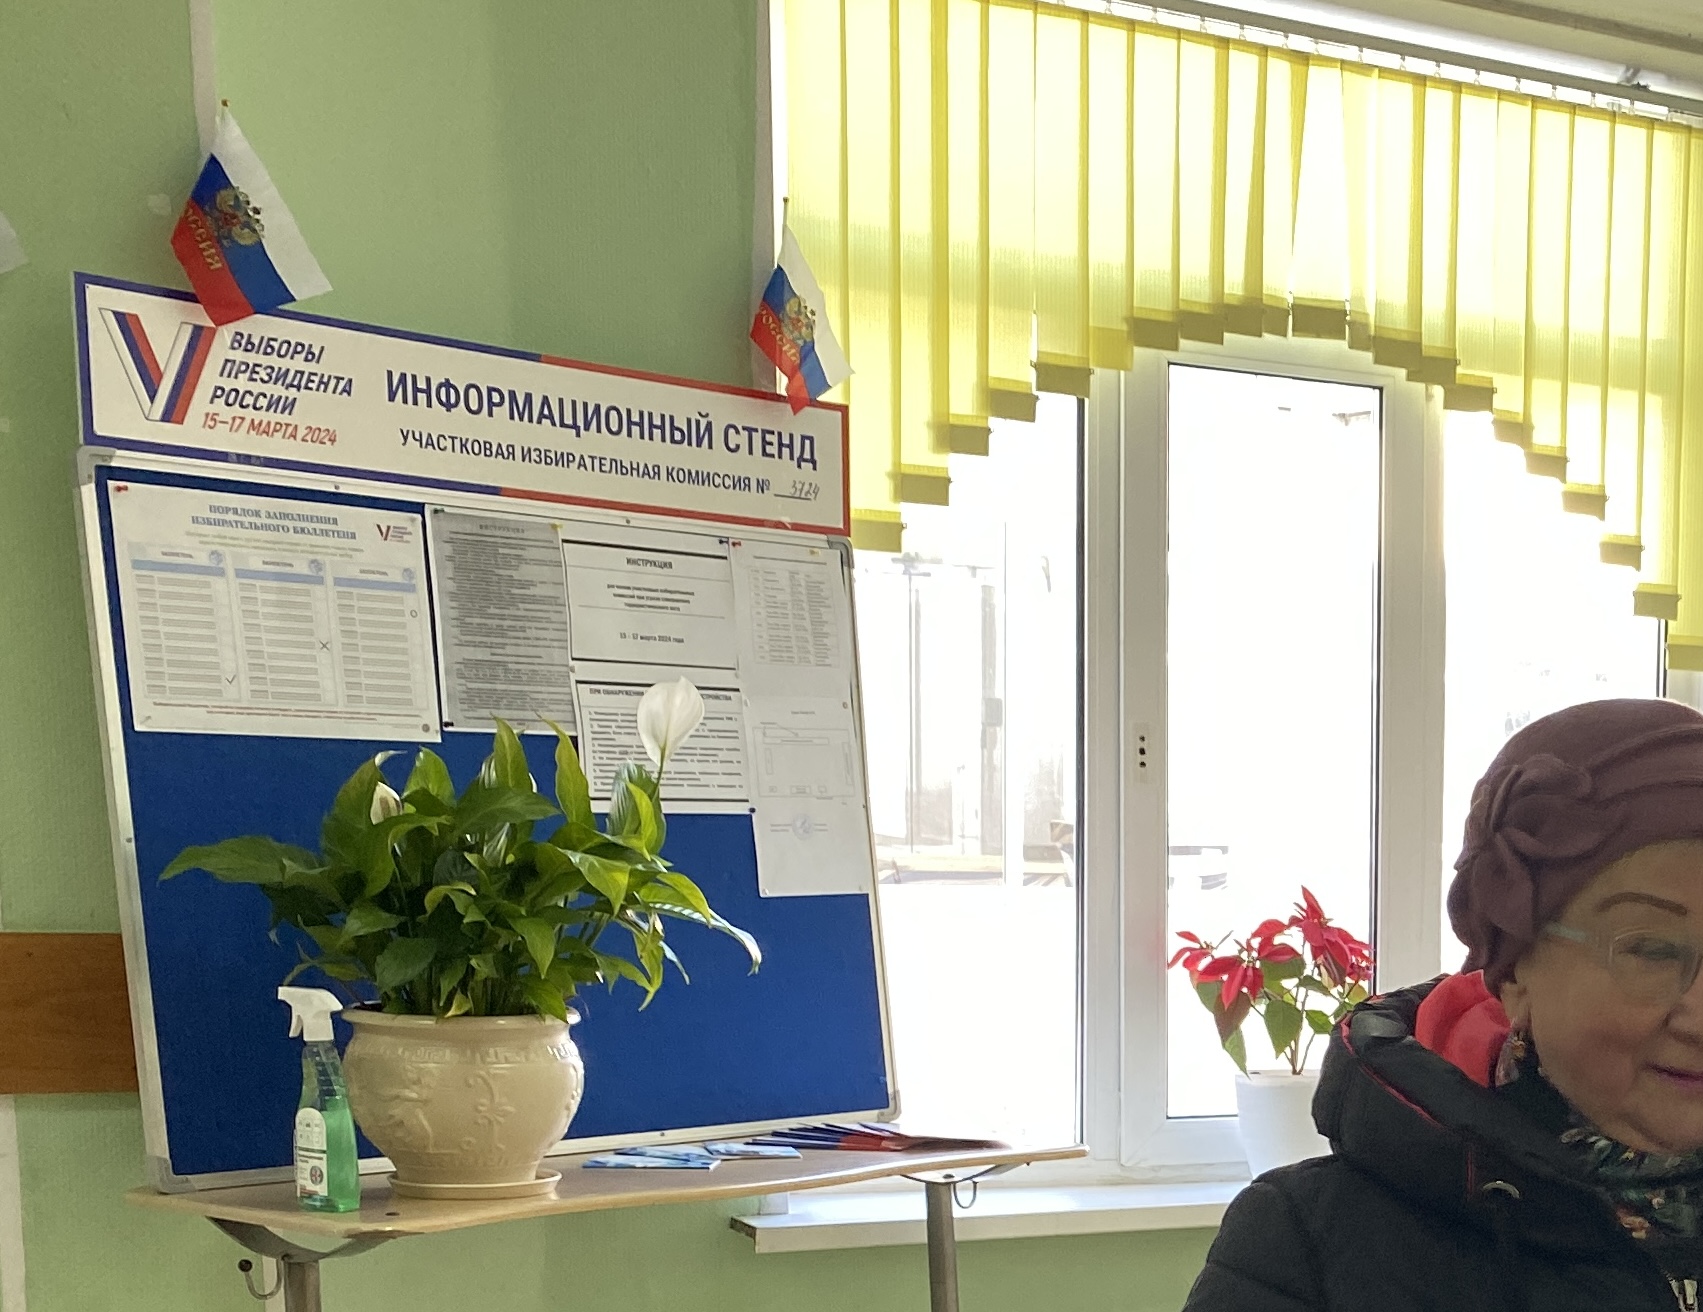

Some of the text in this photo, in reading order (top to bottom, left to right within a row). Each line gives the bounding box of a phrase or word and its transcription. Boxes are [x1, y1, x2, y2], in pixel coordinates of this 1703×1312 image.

[228, 330, 325, 365] ВЫБОРЫ
[218, 358, 353, 398] ПРЕЗИДЕНТА
[209, 385, 297, 417] РОССИИ
[247, 418, 298, 442] МАРТА
[301, 425, 337, 447] 2024
[386, 369, 818, 472] ИНФОРМАЦИОННЫЙ СТЕНД
[399, 427, 770, 495] УЧАСТКОВАЯ ИЗБИРАТЕЛЬНАЯ КОМИССИЯ №
[191, 515, 357, 540] ИЗБИРАТЕЛЬНОГО БЮЛЛЕТЕНЯ
[208, 504, 338, 527] ПОРЯДОК ЗАПОЛНЕНИЯ
[626, 557, 673, 570] ИНСТРУКЦИЯ
